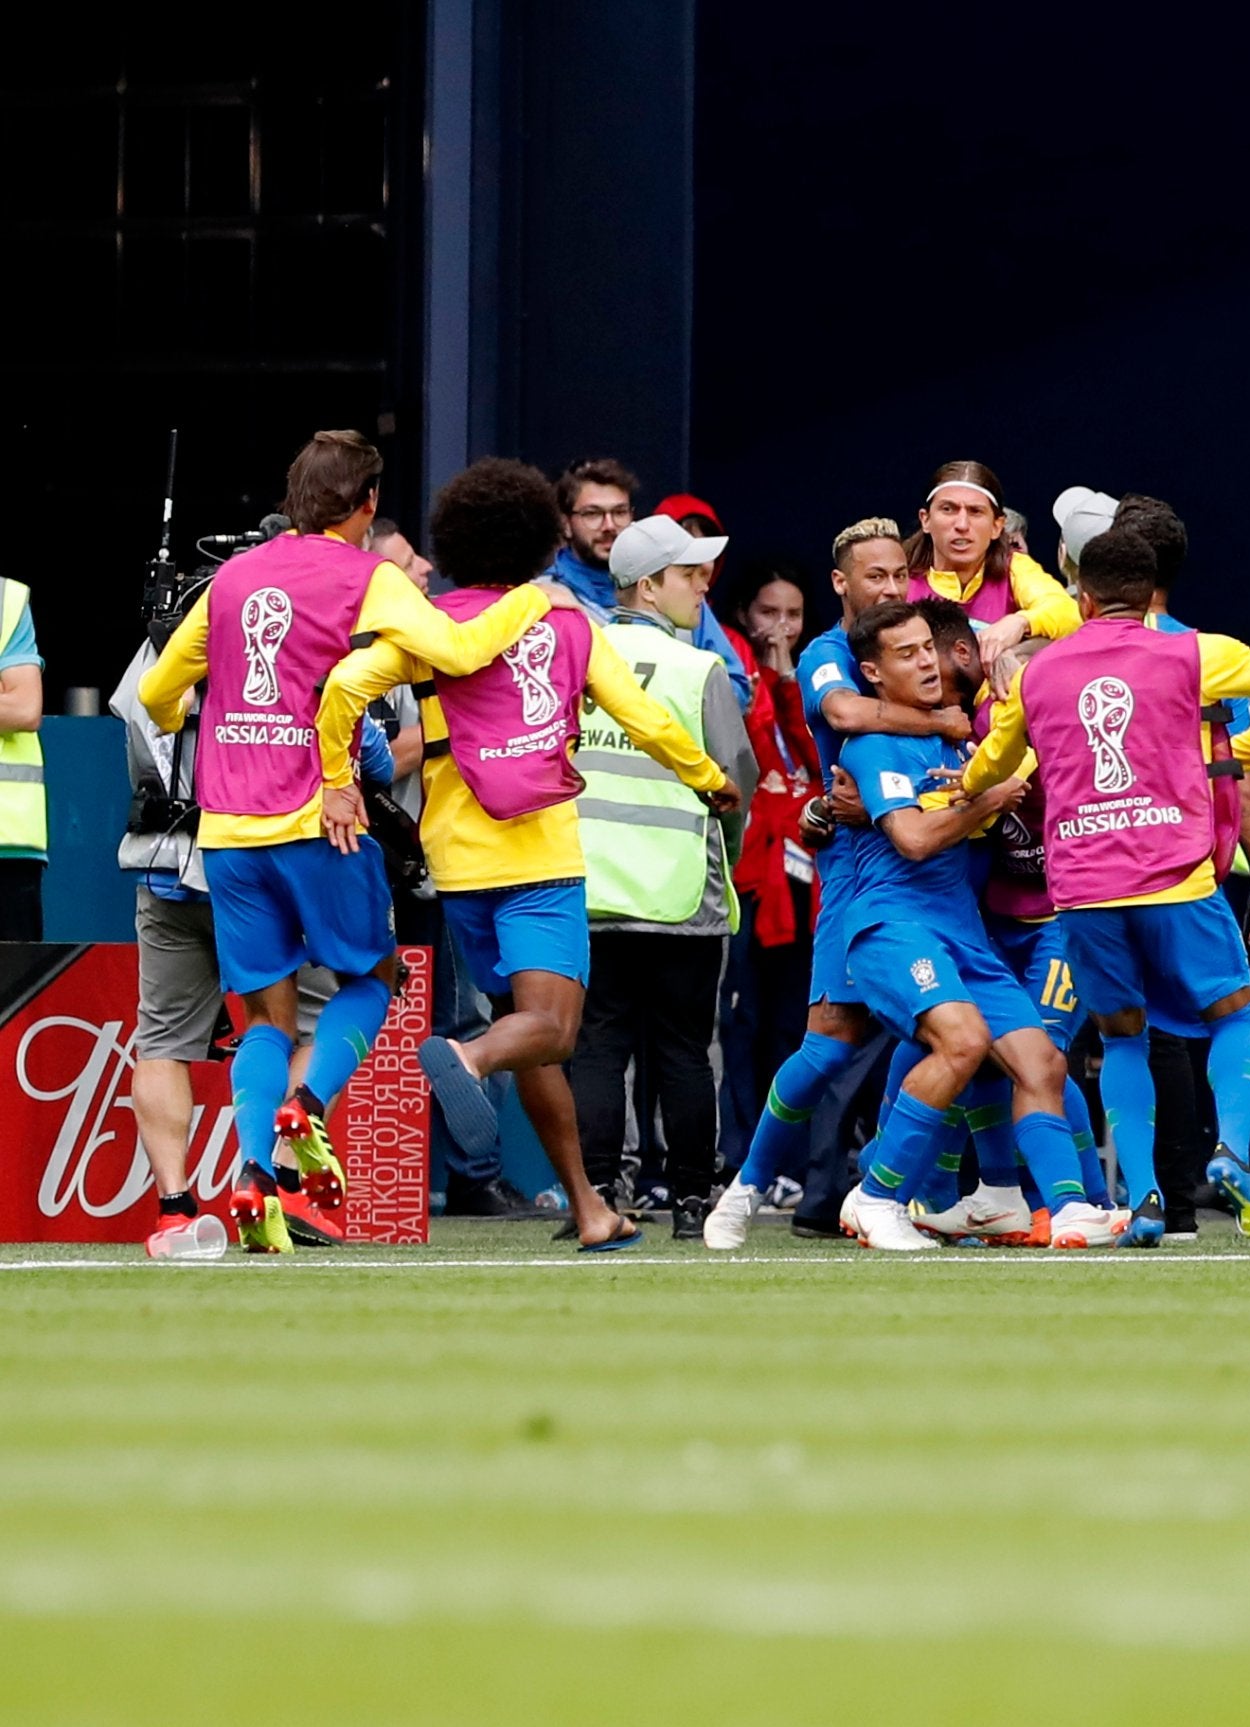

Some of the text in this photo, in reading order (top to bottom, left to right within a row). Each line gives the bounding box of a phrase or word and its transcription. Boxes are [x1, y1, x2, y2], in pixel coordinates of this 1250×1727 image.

[225, 711, 293, 724] FIFA WORLD CUP
[215, 724, 315, 747] RSSIA 2018
[578, 728, 645, 752] EWAR
[479, 734, 559, 761] RUSSIA
[1078, 796, 1152, 814] FIFA WORLD CUP
[1058, 806, 1182, 840] RUSSIA 2018
